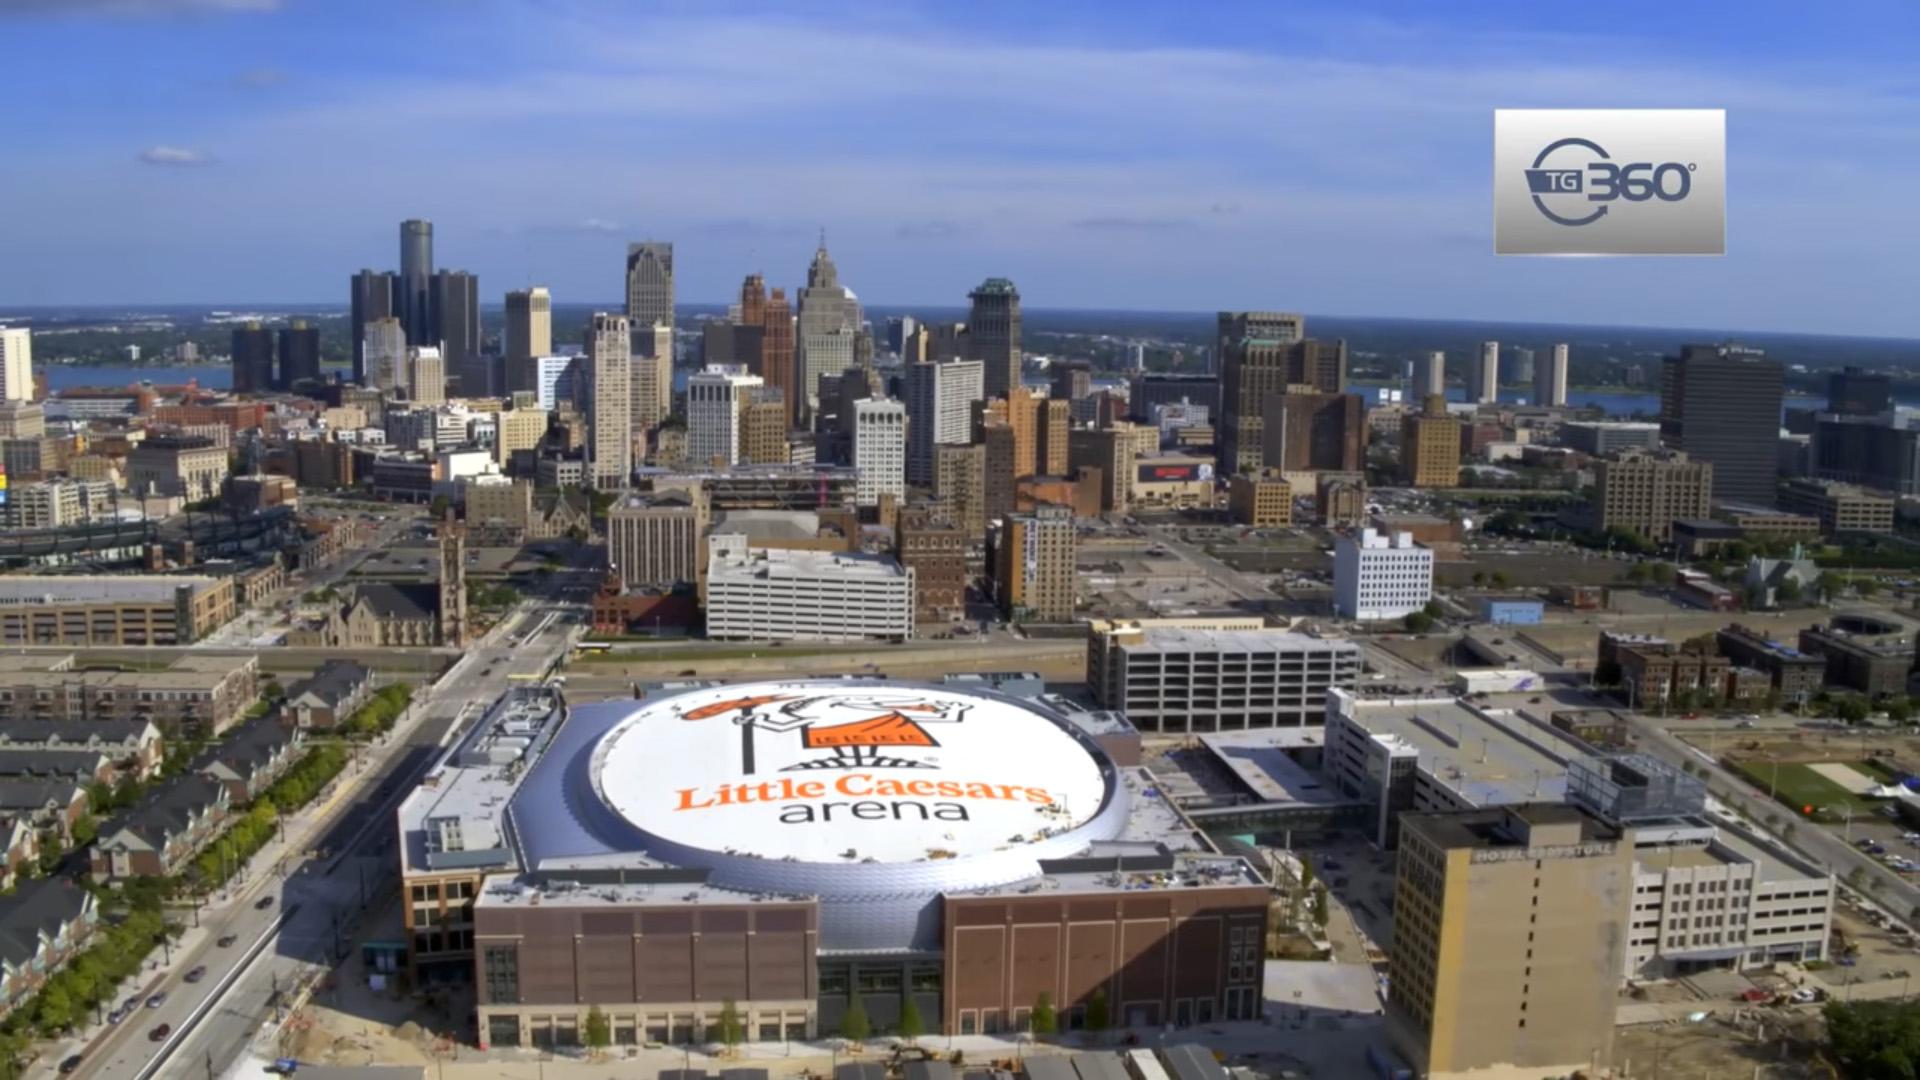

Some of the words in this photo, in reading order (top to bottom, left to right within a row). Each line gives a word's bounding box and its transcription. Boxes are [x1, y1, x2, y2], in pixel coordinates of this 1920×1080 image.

[673, 778, 826, 811] Little
[835, 774, 1054, 804] Caesars
[779, 801, 970, 822] arena
